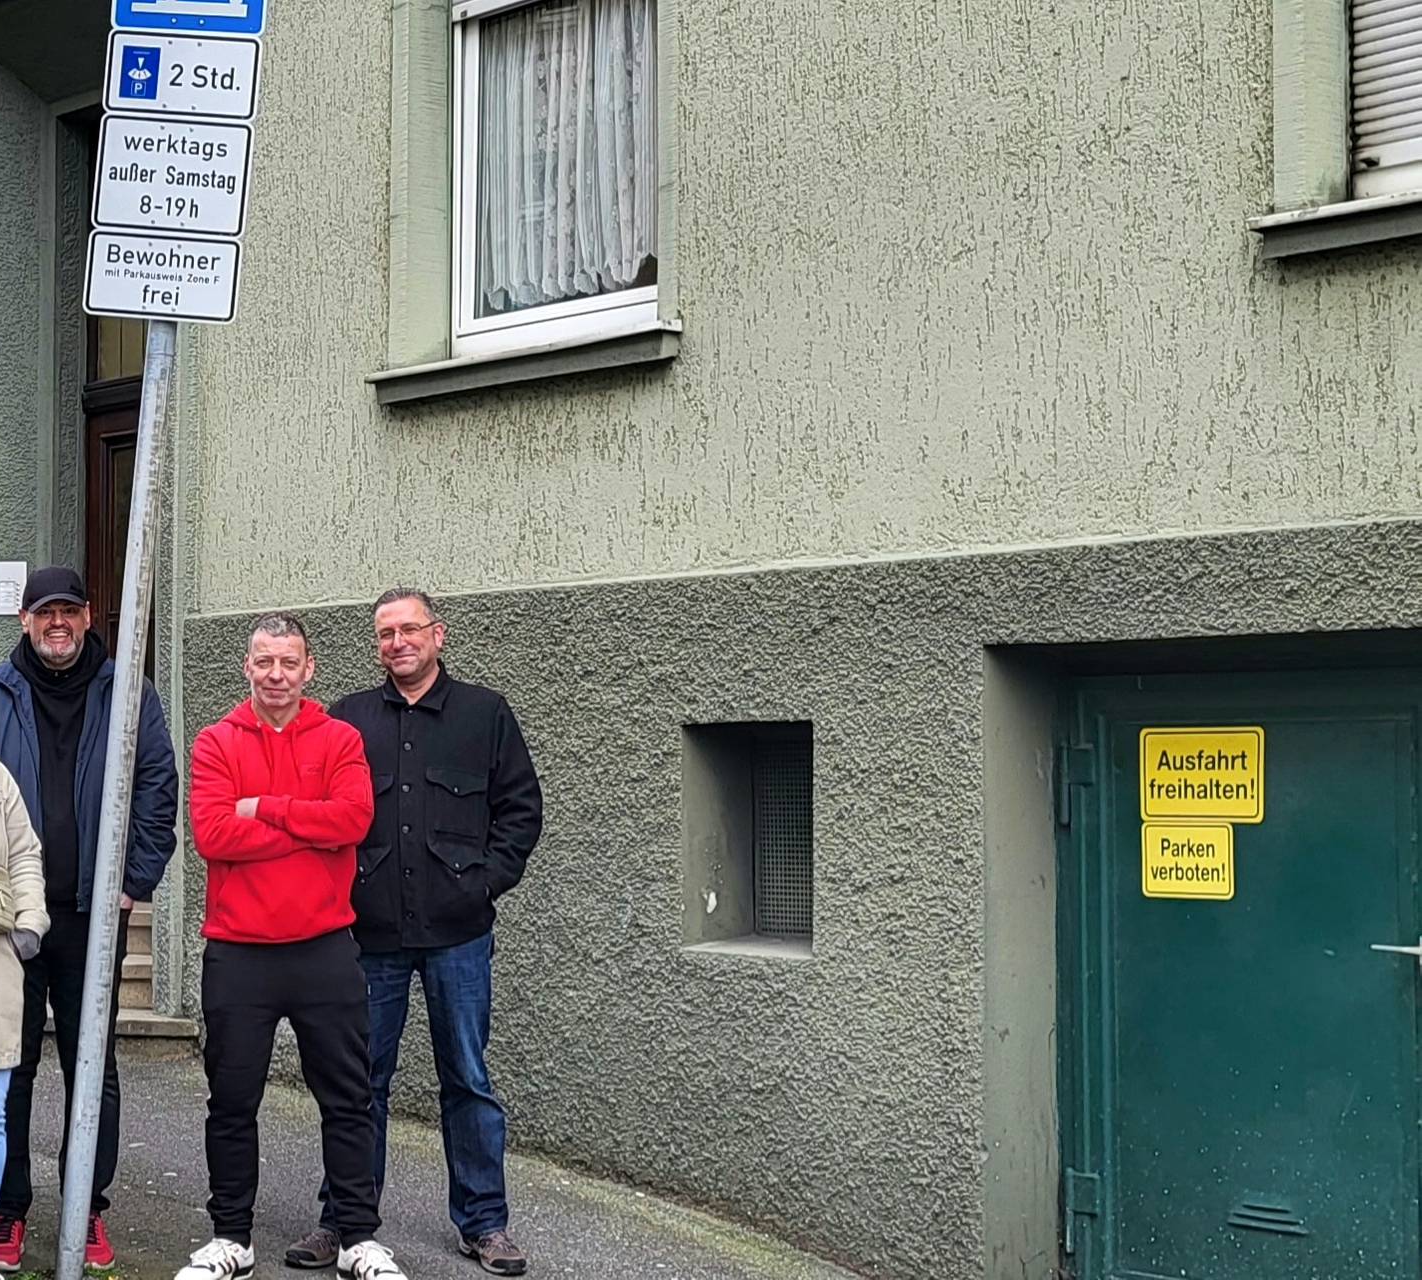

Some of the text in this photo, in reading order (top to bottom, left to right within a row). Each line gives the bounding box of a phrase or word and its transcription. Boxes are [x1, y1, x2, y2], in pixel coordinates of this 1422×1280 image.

[134, 82, 143, 95] P
[169, 63, 241, 91] 2 Std.
[123, 133, 228, 162] werktags
[108, 162, 237, 195] außer Samstag
[106, 243, 221, 271] Bewohner
[104, 268, 220, 284] mit Parkausweis Zone F
[142, 284, 180, 306] frei
[1156, 749, 1248, 772] Ausfahrt
[1148, 777, 1256, 800] freihalten!
[1160, 837, 1216, 859] Parken
[1150, 861, 1226, 882] verboten!
